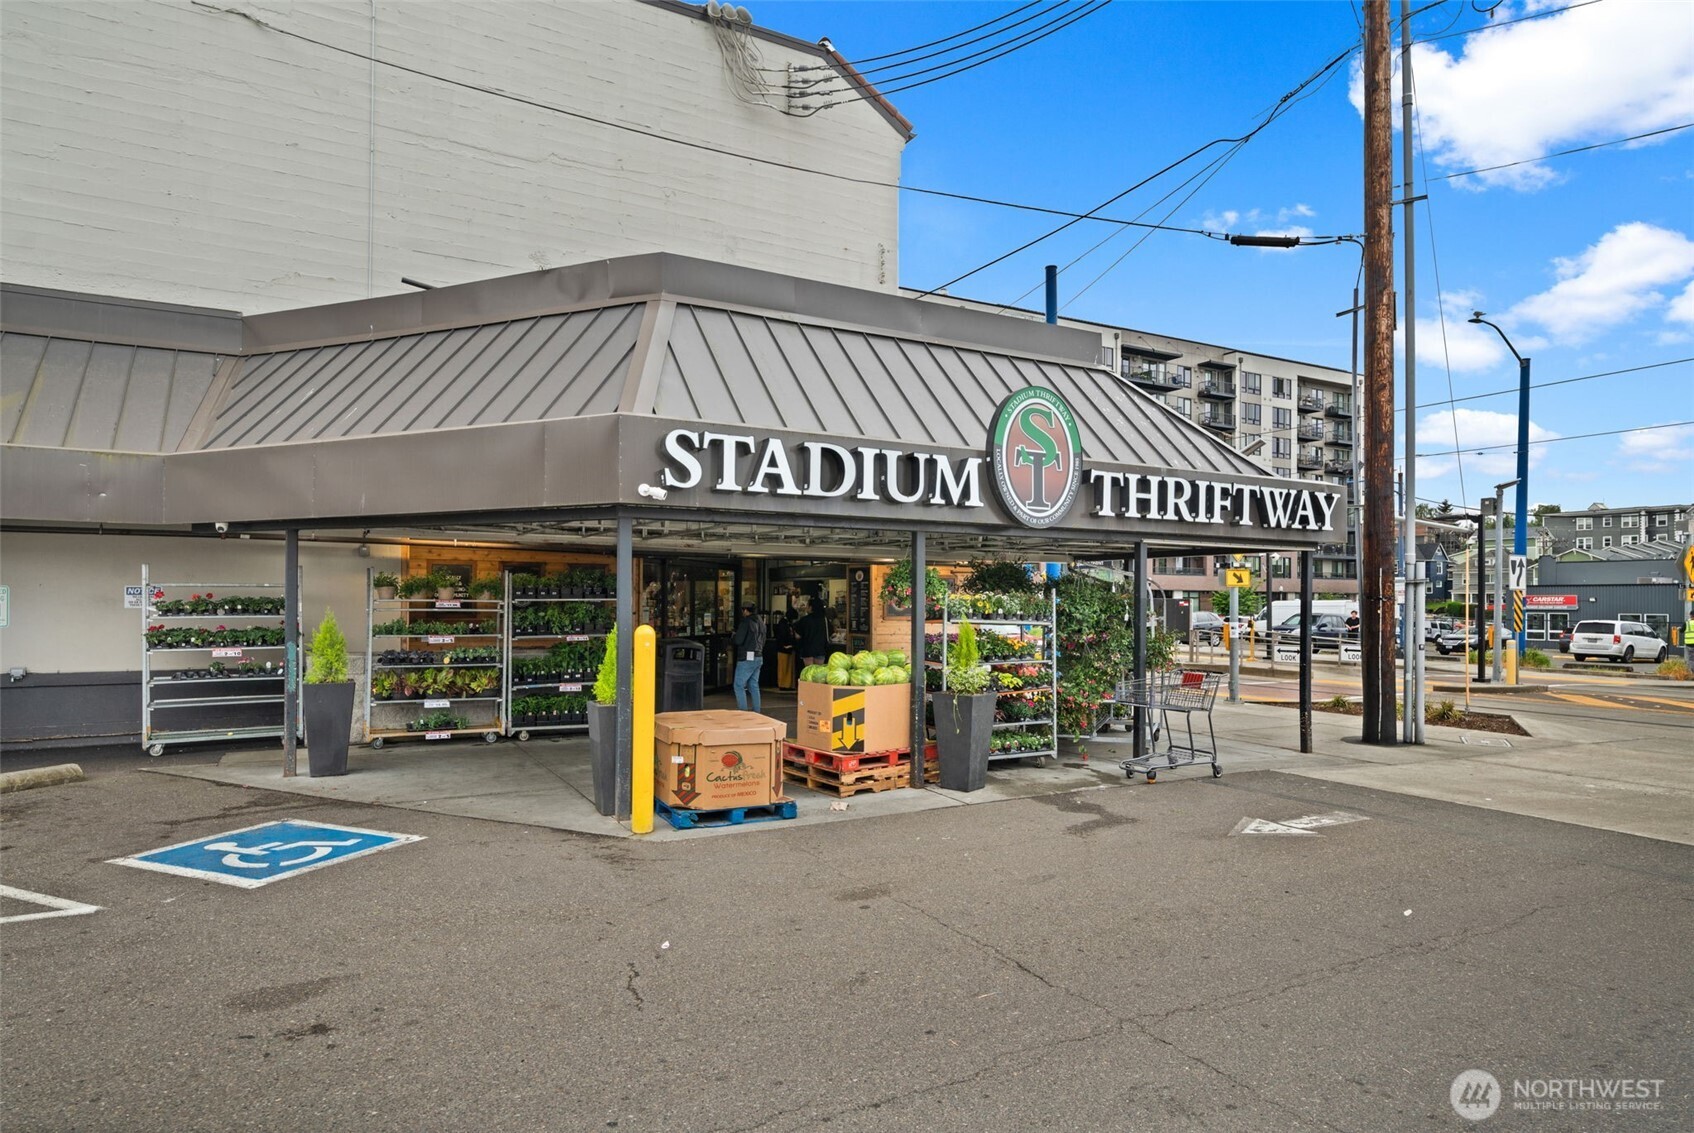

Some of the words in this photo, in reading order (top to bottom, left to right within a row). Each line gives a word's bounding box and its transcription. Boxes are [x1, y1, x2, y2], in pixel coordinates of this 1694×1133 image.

[1007, 390, 1034, 413] STADIUM
[1035, 390, 1071, 421] THRIFTWAY
[662, 428, 984, 508] STADIUM
[1089, 468, 1341, 531] THRIFTWAY
[996, 448, 1004, 480] LOCALLY
[1001, 480, 1015, 507] OWNED
[1016, 508, 1030, 521] PART
[1038, 517, 1050, 525] OUR
[1049, 490, 1074, 522] COMMUNITY
[713, 780, 760, 789] Watermelons
